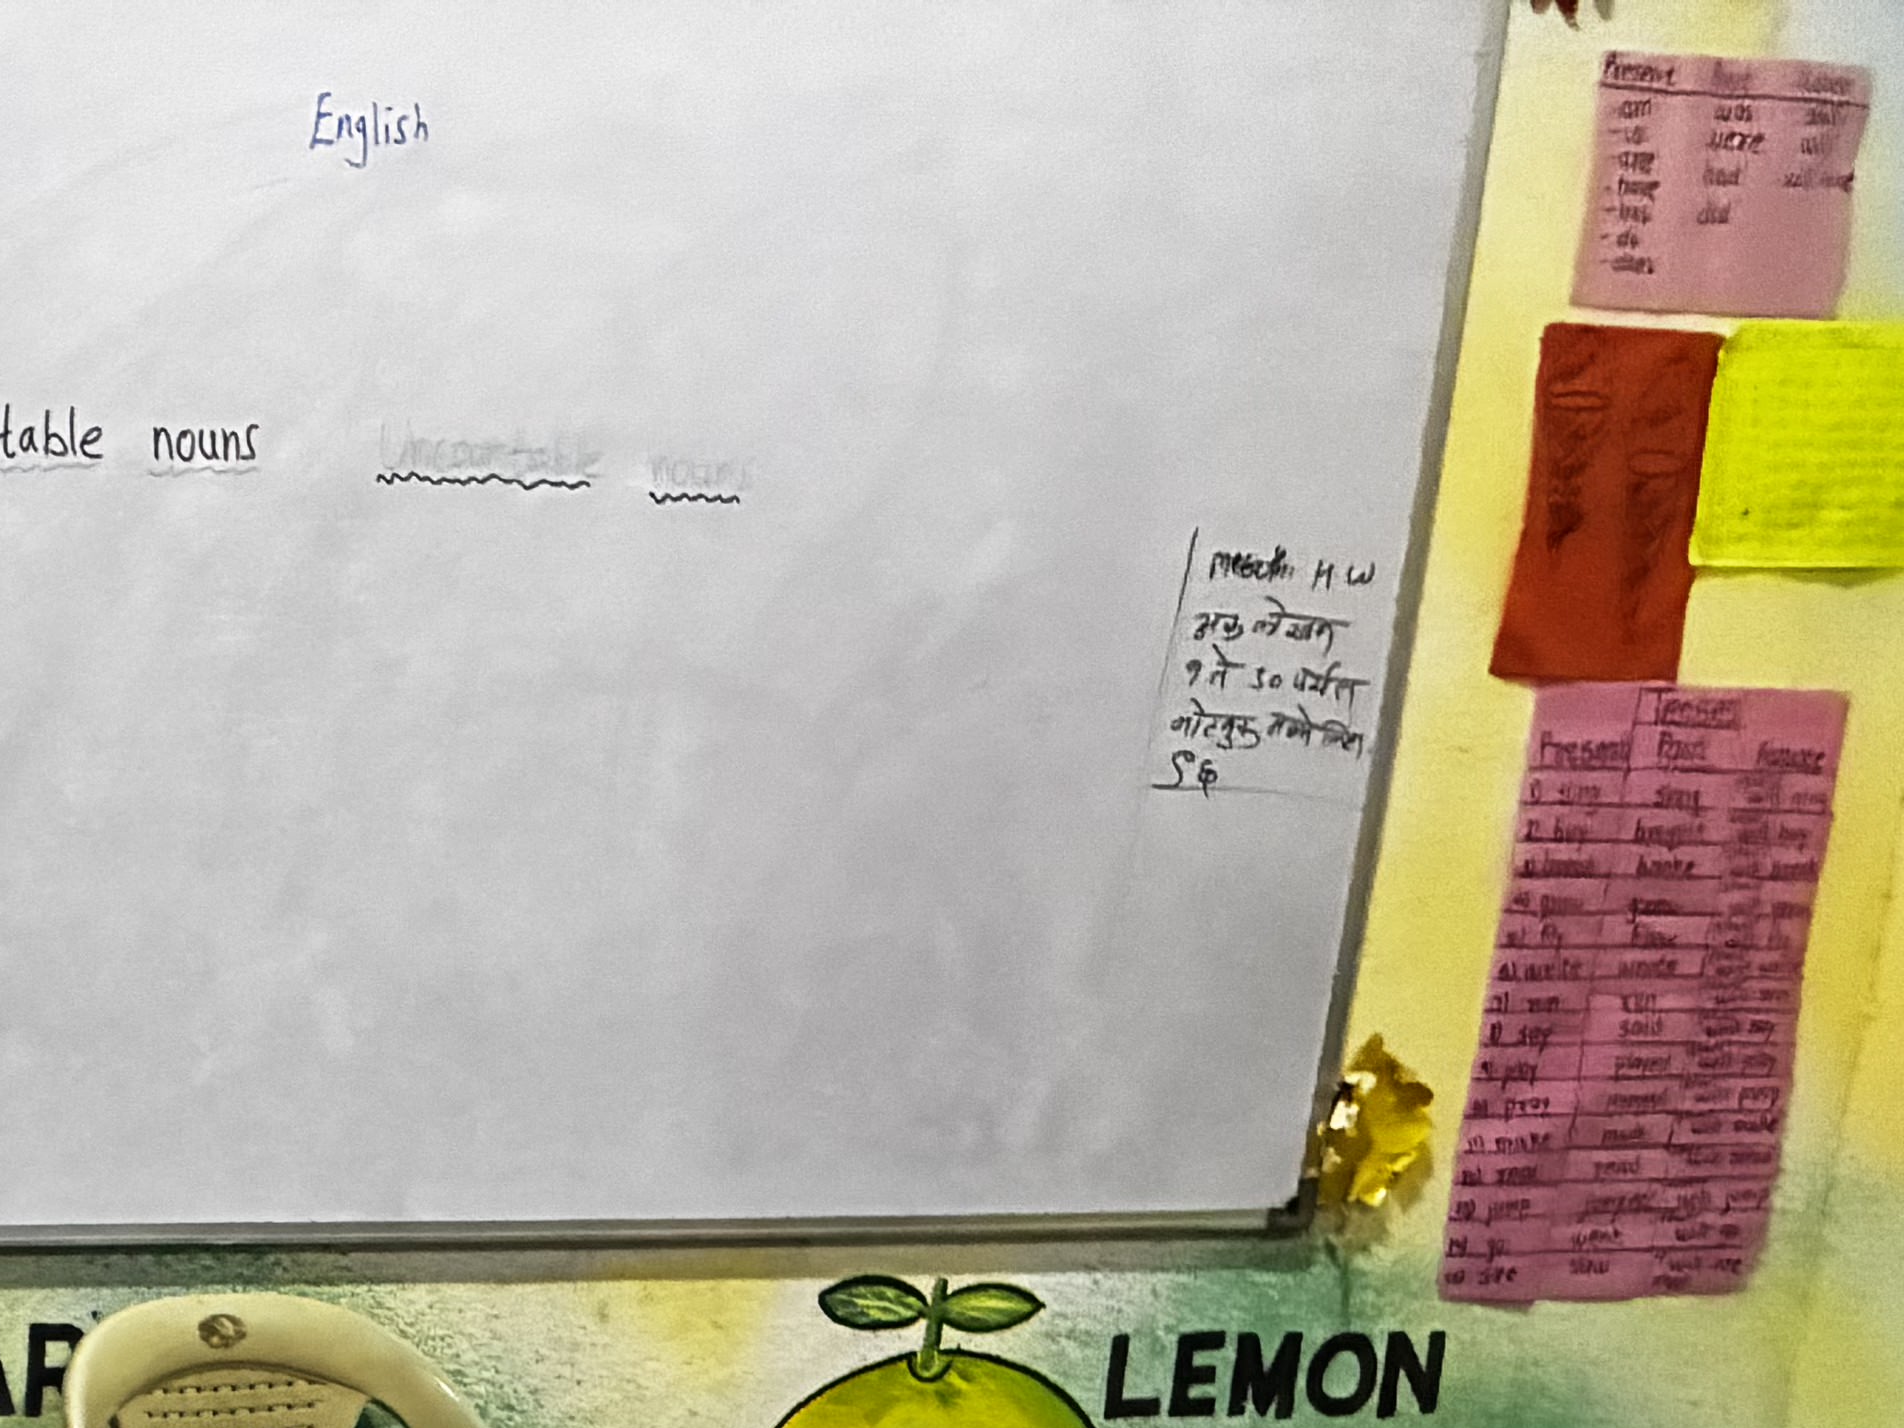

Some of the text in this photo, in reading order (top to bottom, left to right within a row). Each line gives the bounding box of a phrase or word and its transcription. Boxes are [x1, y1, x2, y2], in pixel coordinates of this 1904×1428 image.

[310, 92, 430, 168] English
[152, 422, 259, 462] nouns
[1104, 1331, 1446, 1419] LEMON
